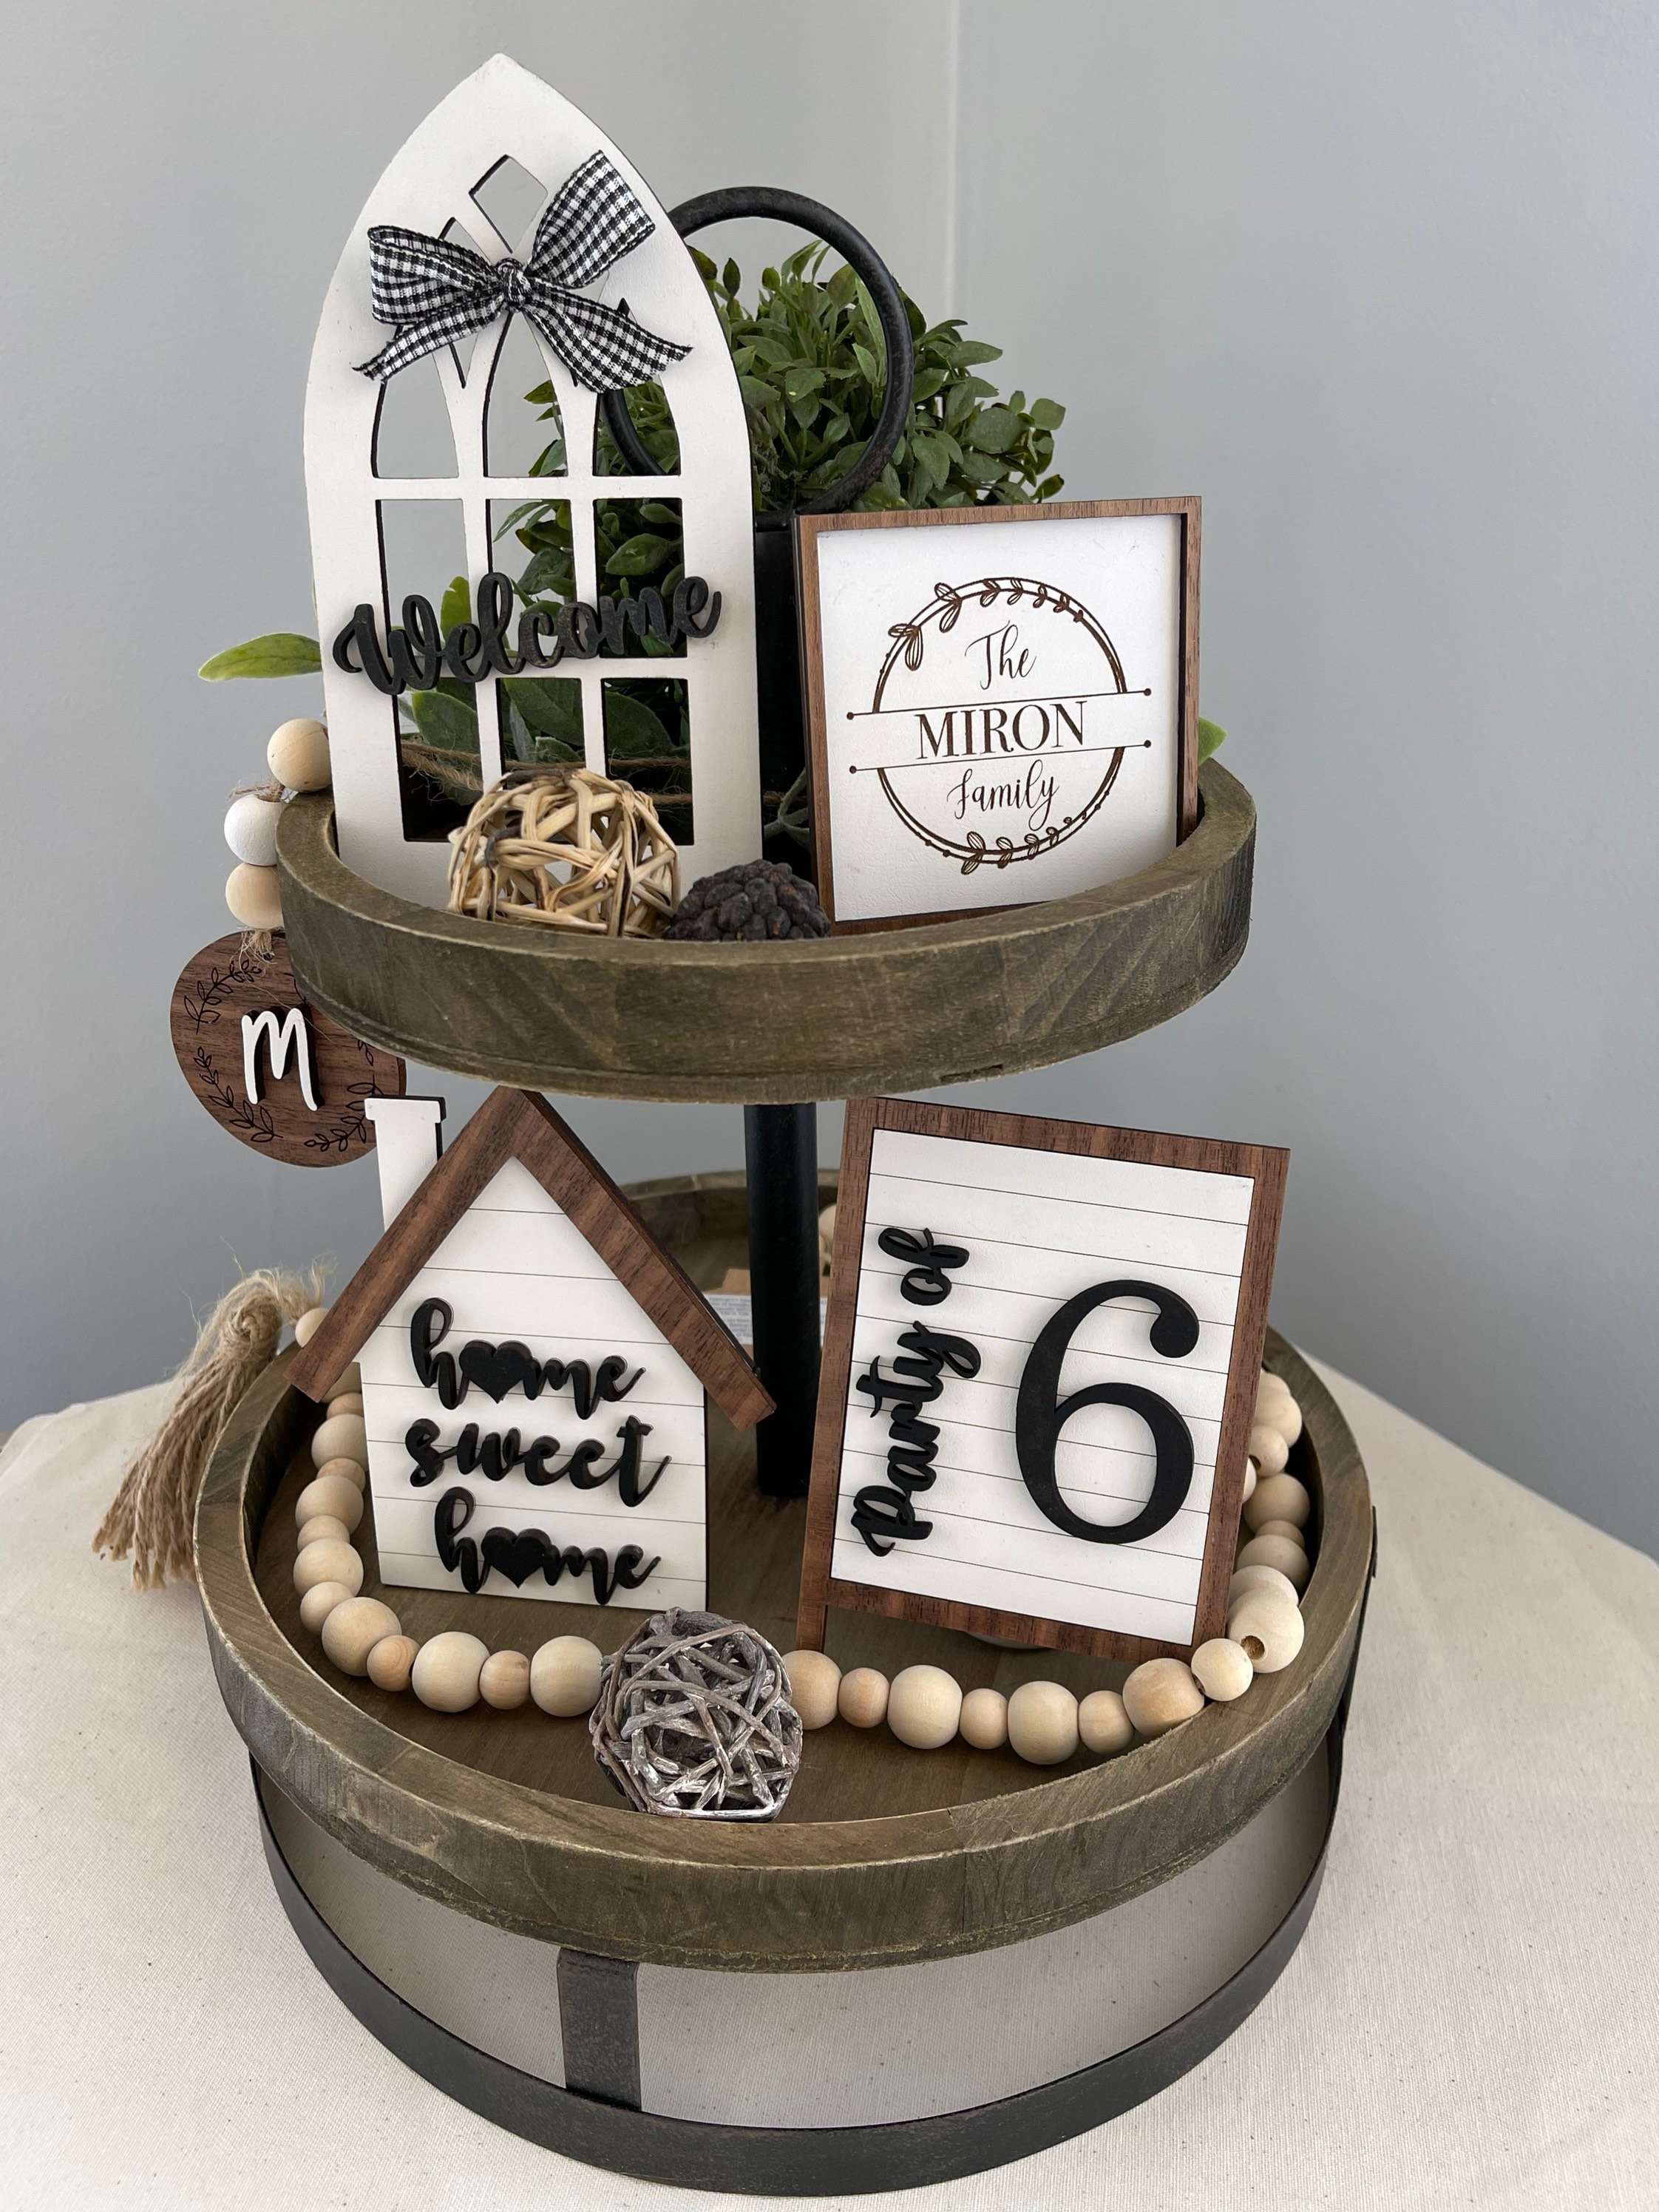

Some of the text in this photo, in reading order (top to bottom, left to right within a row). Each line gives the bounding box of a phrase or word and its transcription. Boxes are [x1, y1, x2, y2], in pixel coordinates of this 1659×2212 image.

[333, 572, 721, 695] Welcome
[965, 620, 1037, 690] The
[915, 701, 1087, 760] MIRON
[850, 1227, 981, 1557] Party of
[1016, 1279, 1200, 1544] 6
[405, 1414, 672, 1507] sweet
